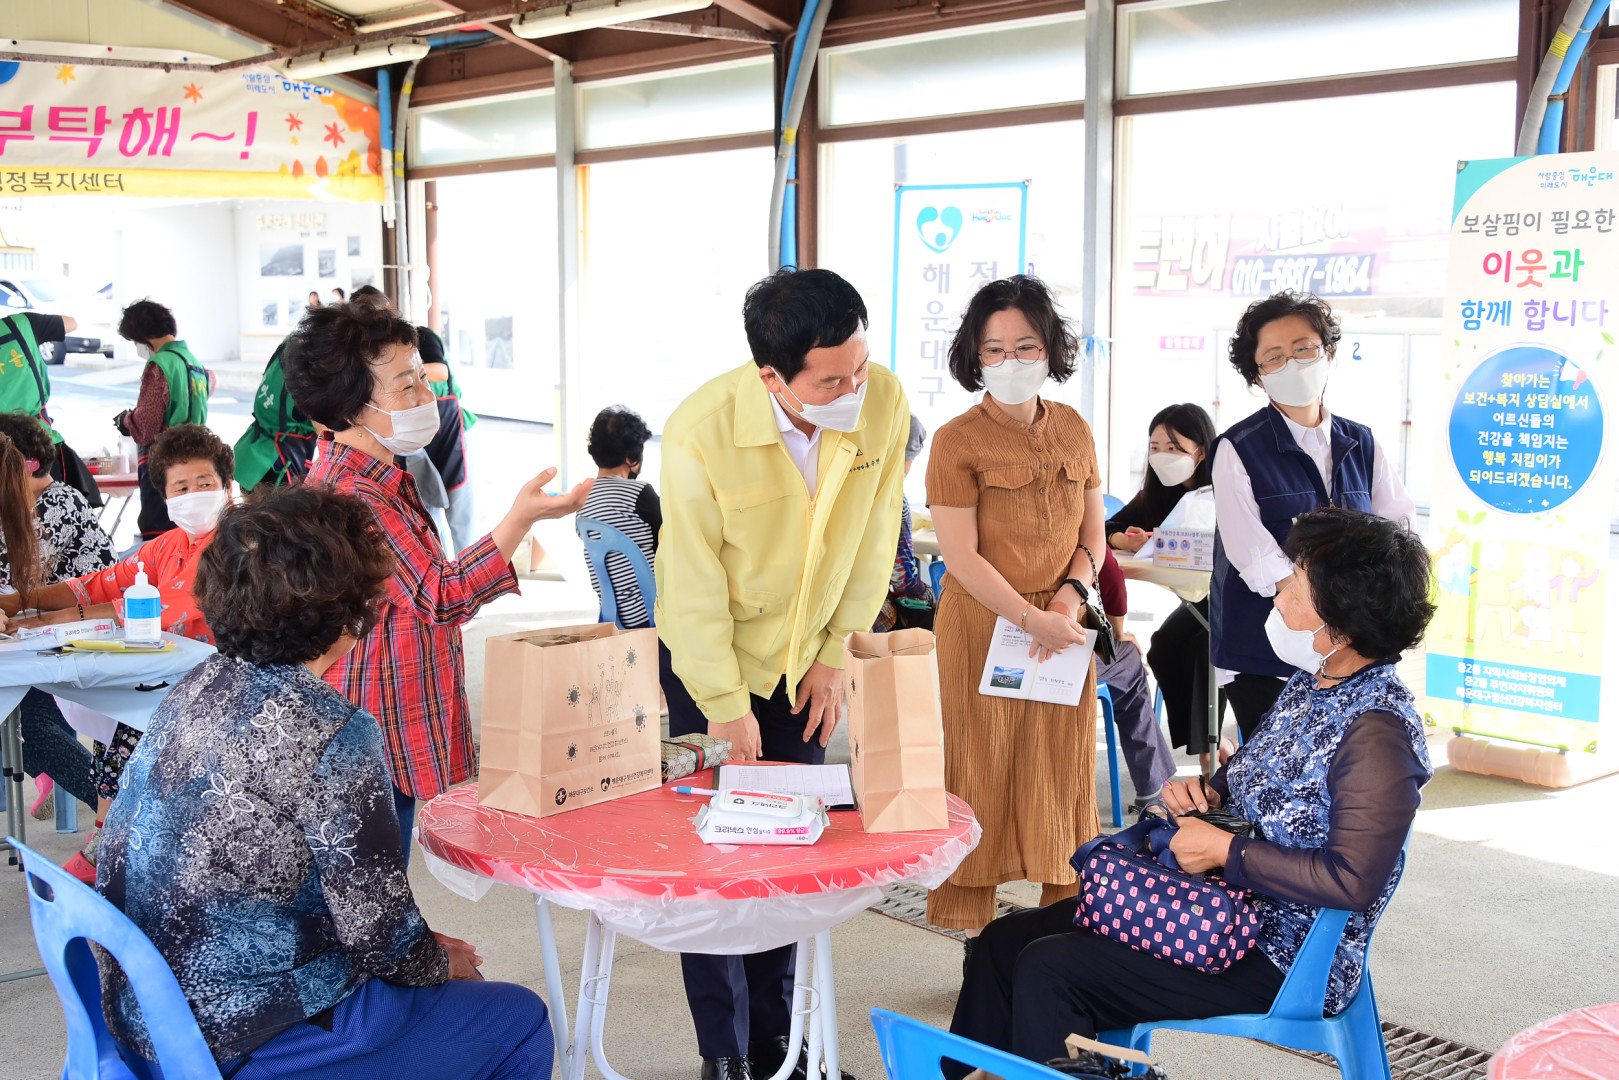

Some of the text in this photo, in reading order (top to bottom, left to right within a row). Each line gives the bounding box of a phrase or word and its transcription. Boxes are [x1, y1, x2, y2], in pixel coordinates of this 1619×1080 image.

[1538, 171, 1565, 180] 사람중심
[1540, 181, 1568, 189] 미래도시
[1568, 166, 1613, 187] 해운대
[1461, 211, 1542, 237] 보살핌이
[1550, 208, 1616, 235] 필요한
[1482, 248, 1585, 288] 이웃과
[1461, 298, 1609, 331] 함께 합니다
[1501, 372, 1551, 389] 찾아가는
[1463, 391, 1590, 410] 보건+복지 상담실에서
[1493, 412, 1555, 429] 어르신들의
[1478, 431, 1569, 450] 건강을 책임지는
[1482, 450, 1506, 466] 행복
[1469, 469, 1573, 490] 되어드리겠습니다.
[1464, 676, 1555, 699] 중2동 주민자치위원회
[714, 825, 745, 835] 크리넥스
